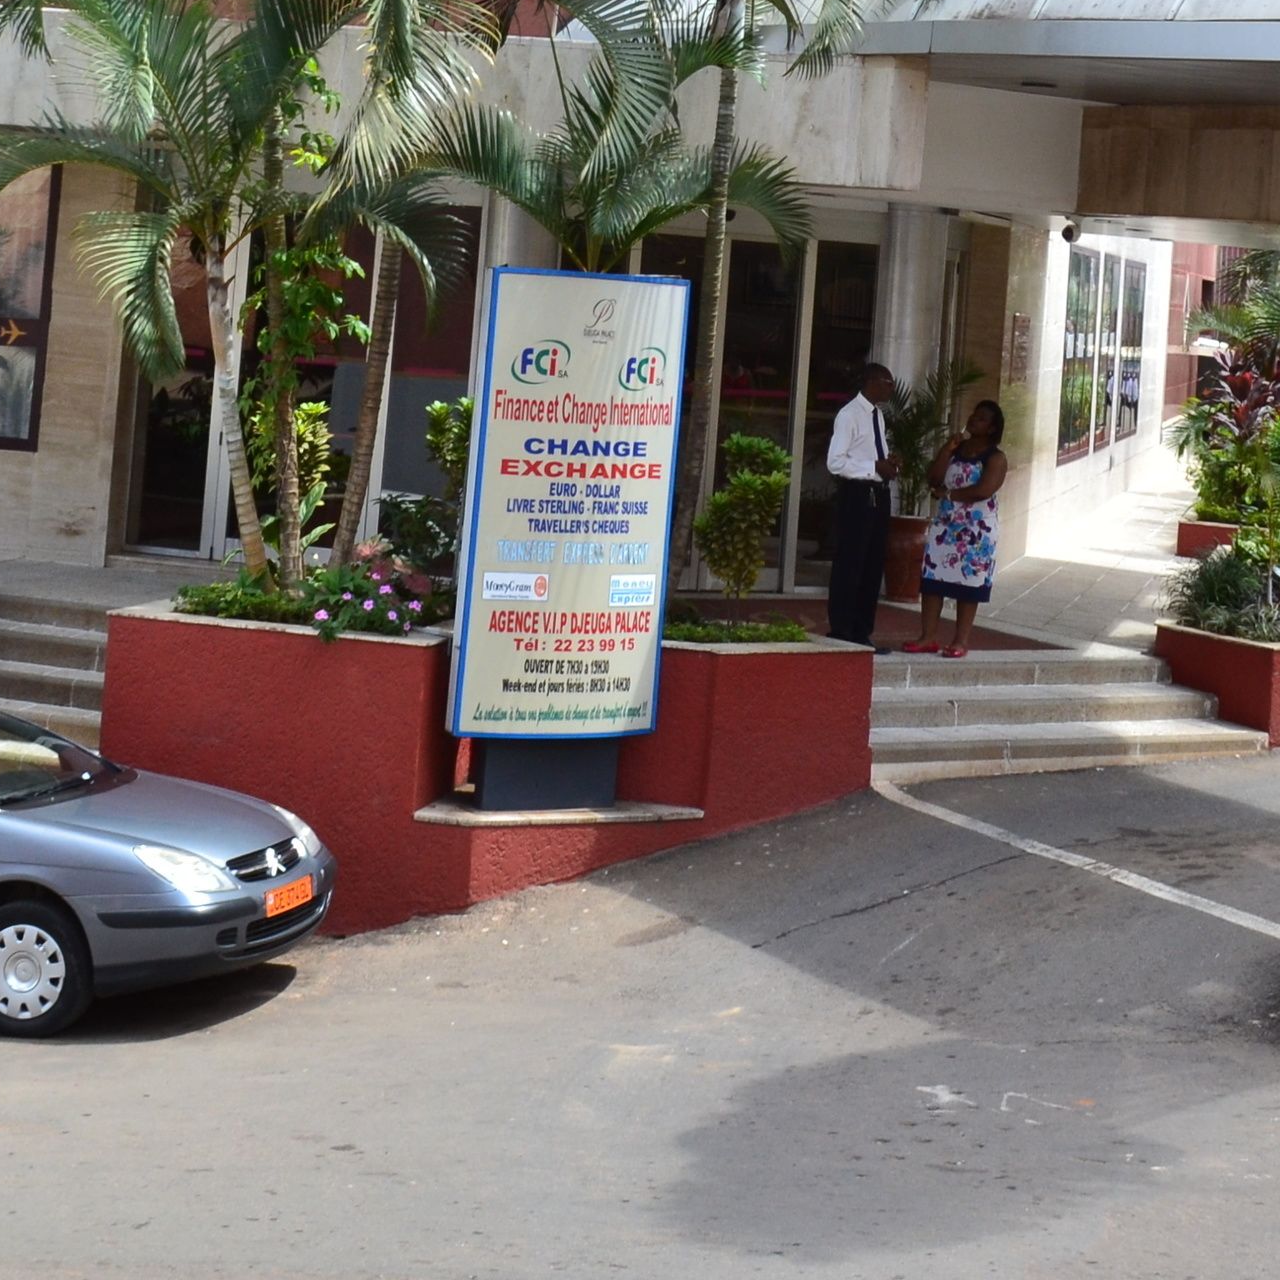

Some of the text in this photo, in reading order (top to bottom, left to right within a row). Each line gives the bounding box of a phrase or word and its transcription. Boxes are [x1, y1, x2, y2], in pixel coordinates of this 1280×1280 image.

[494, 389, 673, 433] Finance et Change International
[524, 438, 647, 457] CHANGE
[500, 459, 662, 479] EXCHANGE
[549, 482, 577, 496] EURO
[585, 484, 621, 498] DOLLAR
[507, 498, 535, 513] LIVRE
[538, 499, 584, 514] STERLING
[592, 501, 620, 515] FRANC
[621, 501, 648, 515] SUISSE
[528, 518, 629, 534] TRAVELLER'S CHEQUES
[485, 580, 531, 593] MoneyGram
[489, 610, 651, 634] AGENCE V.I.P DJEUGA PALACE
[554, 639, 572, 652] 22
[577, 639, 594, 652] 23
[599, 639, 615, 652] 99
[620, 638, 635, 651] 15
[524, 659, 553, 674] OUVERT
[555, 660, 564, 674] DE
[566, 660, 583, 674] 7H30
[502, 679, 536, 693] Week-end
[538, 680, 546, 693] et
[546, 679, 564, 697] jours
[612, 677, 631, 692] 14H30
